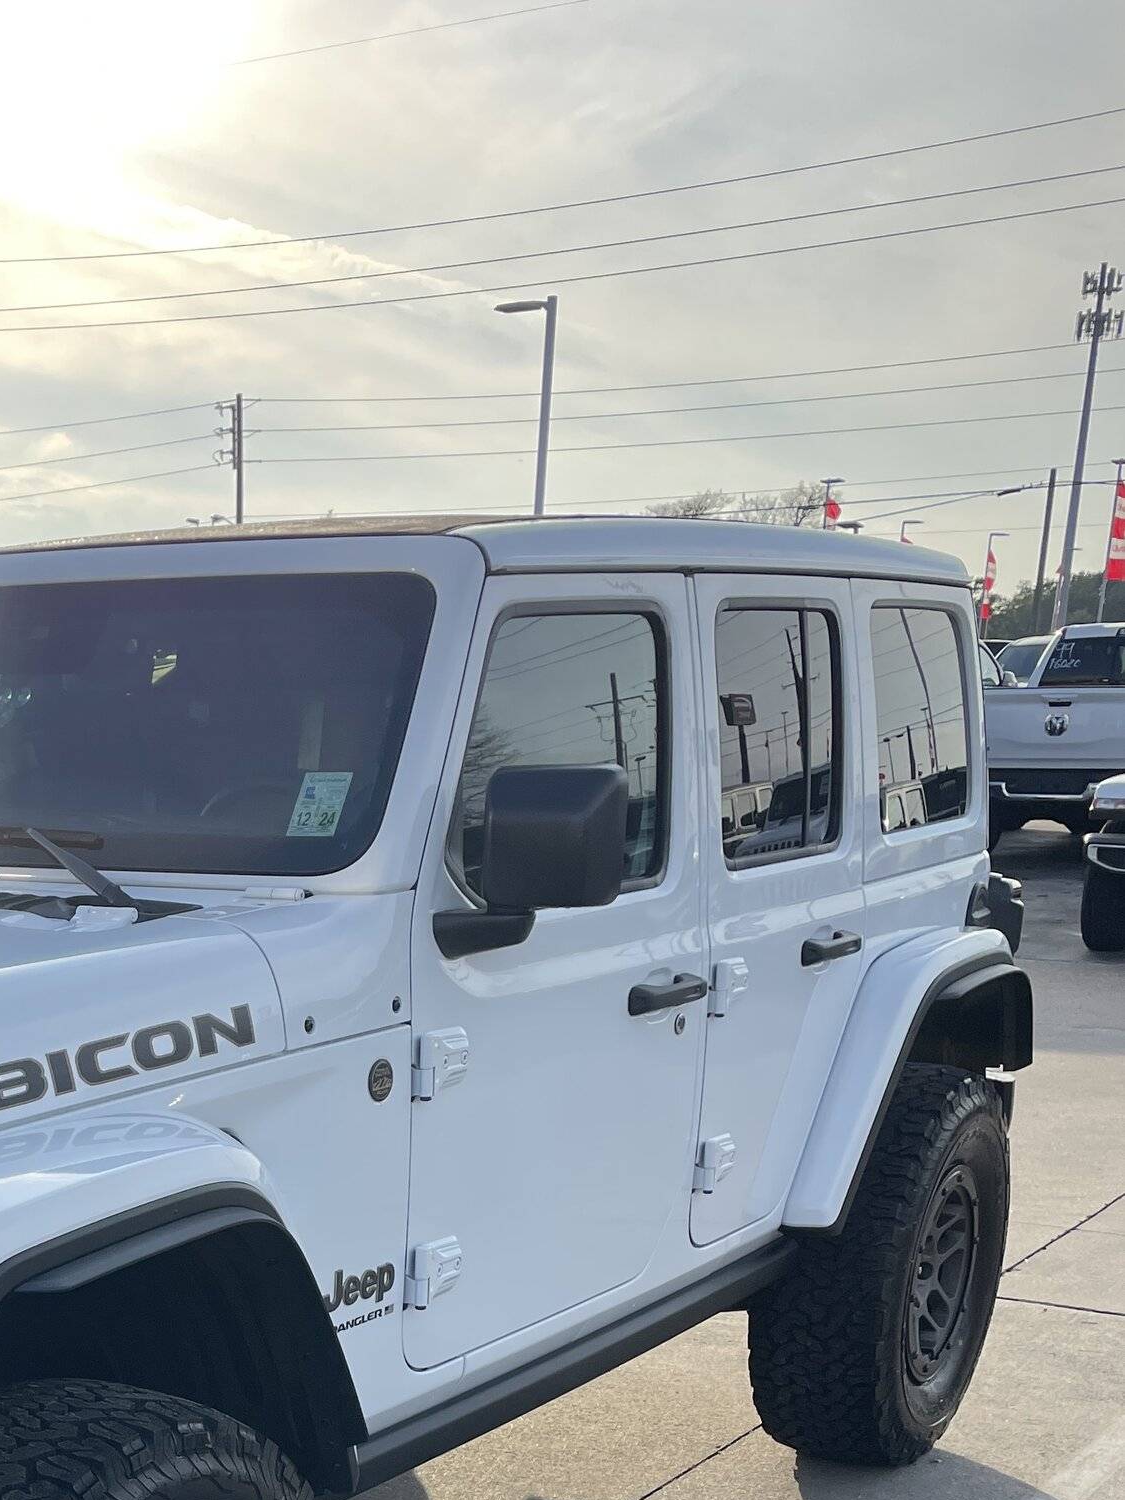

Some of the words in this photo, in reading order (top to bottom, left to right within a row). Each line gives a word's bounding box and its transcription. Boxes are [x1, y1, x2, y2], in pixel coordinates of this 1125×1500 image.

[296, 811, 312, 827] 12
[318, 811, 336, 827] 24
[322, 1261, 395, 1313] Jeep
[334, 1308, 383, 1334] ANGLER
